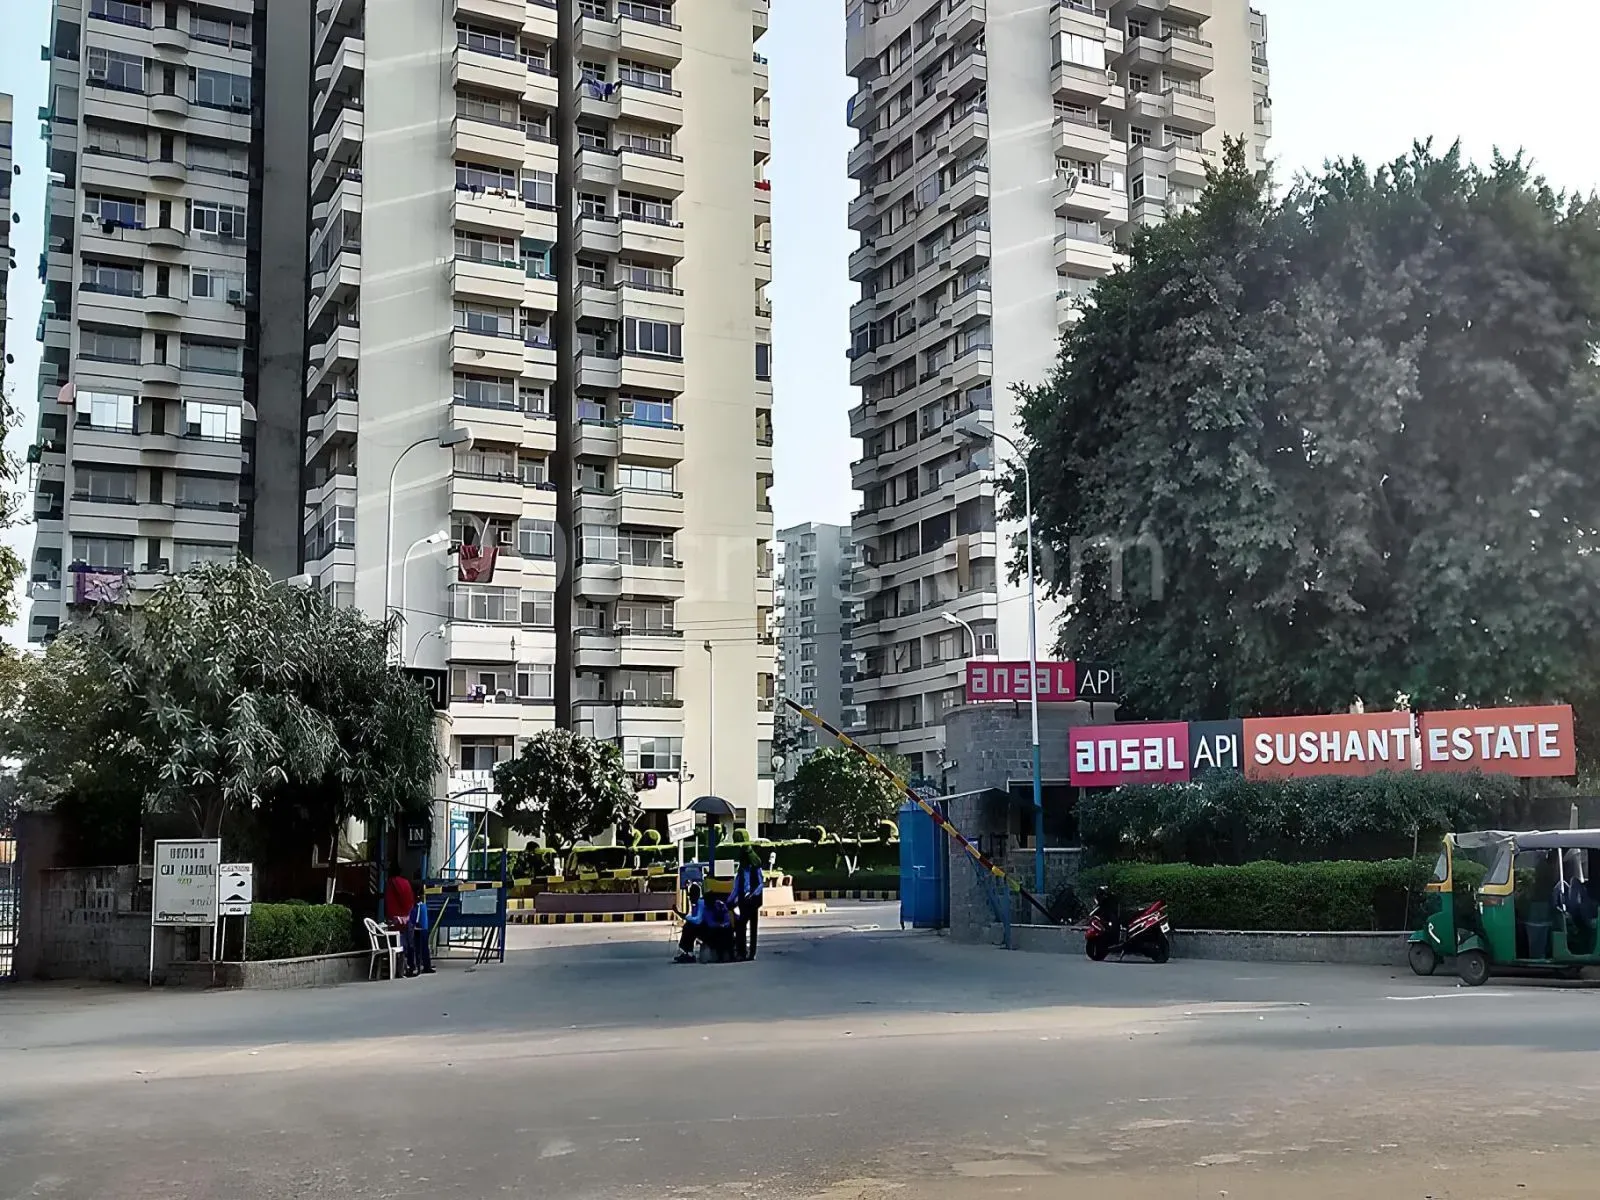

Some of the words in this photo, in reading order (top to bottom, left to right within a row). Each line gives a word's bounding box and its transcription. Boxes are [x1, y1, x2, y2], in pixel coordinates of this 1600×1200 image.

[1080, 669, 1115, 694] API
[1194, 734, 1238, 768] API
[1254, 728, 1410, 765] SUSHANT
[1429, 724, 1560, 761] ESTATE
[409, 828, 424, 841] IN
